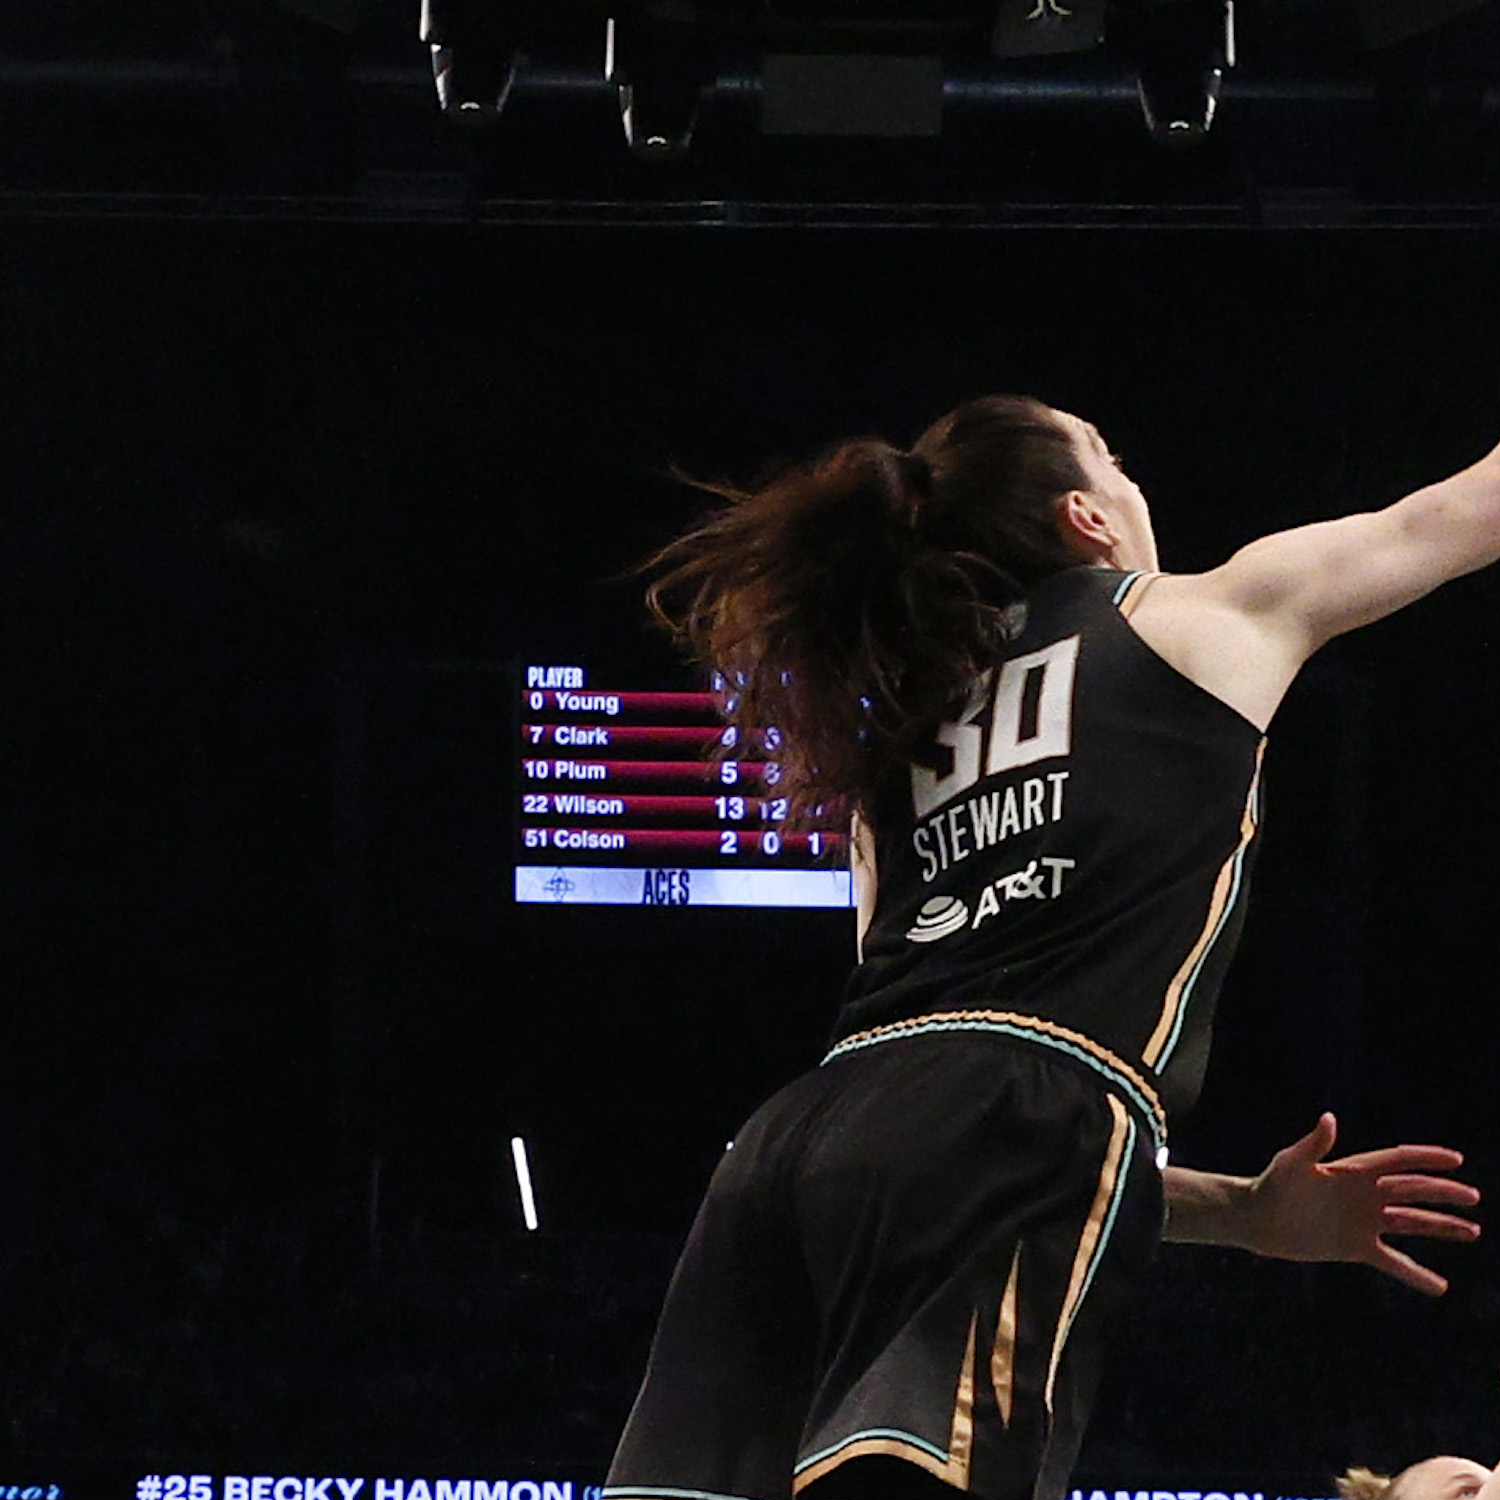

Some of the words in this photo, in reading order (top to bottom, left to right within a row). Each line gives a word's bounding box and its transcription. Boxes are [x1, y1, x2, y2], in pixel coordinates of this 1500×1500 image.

[528, 667, 583, 688] PLAYER
[530, 692, 543, 710] 0
[555, 692, 621, 715] Young
[529, 726, 543, 744] 7
[554, 726, 609, 745] Clark
[720, 726, 738, 749] 4
[910, 634, 1081, 818] 30
[525, 761, 548, 779] 10
[554, 761, 607, 780] Plum
[720, 760, 738, 784] 5
[523, 795, 548, 814] 22
[554, 795, 623, 815] Wilson
[714, 796, 745, 820] 13
[759, 798, 788, 820] 12
[913, 771, 1070, 883] STEWART
[525, 829, 548, 848] 51
[553, 829, 625, 849] Colson
[720, 831, 737, 854] 2
[763, 832, 780, 854] 0
[808, 833, 819, 855] 1
[643, 869, 690, 904] ACES
[972, 856, 1075, 930] AT&T
